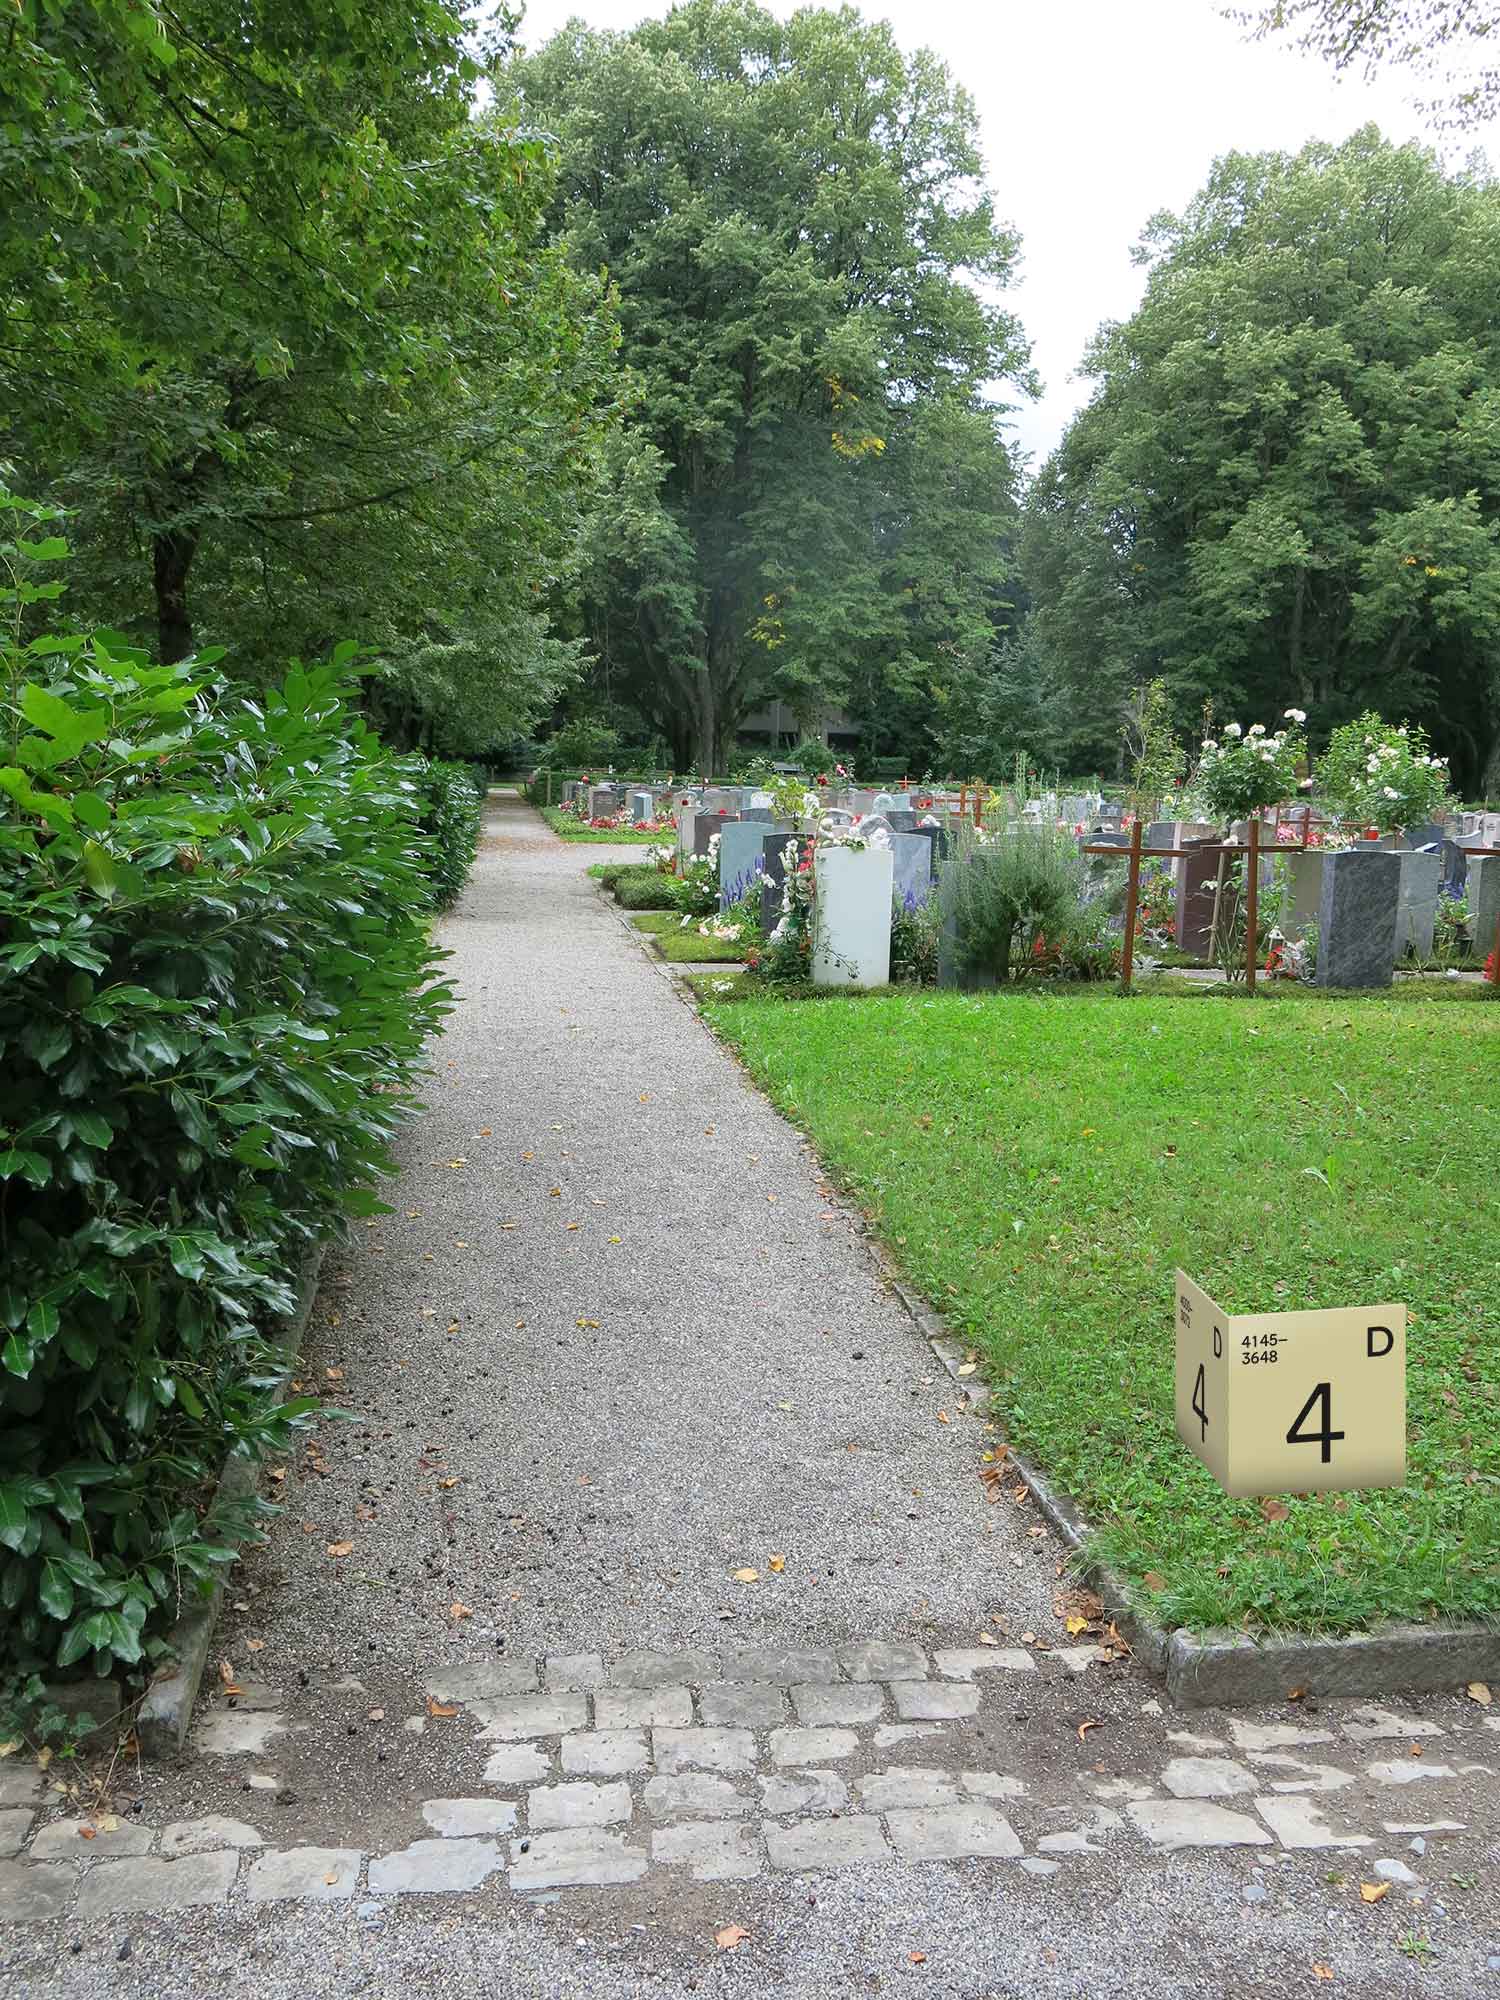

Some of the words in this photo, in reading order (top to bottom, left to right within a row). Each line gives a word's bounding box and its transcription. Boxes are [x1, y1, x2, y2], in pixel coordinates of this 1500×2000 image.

[1213, 1325, 1222, 1359] D
[1241, 1333, 1288, 1348] 4145-
[1367, 1326, 1394, 1357] D
[1241, 1350, 1278, 1365] 3648
[1192, 1363, 1209, 1444] 4
[1286, 1382, 1345, 1464] 4
